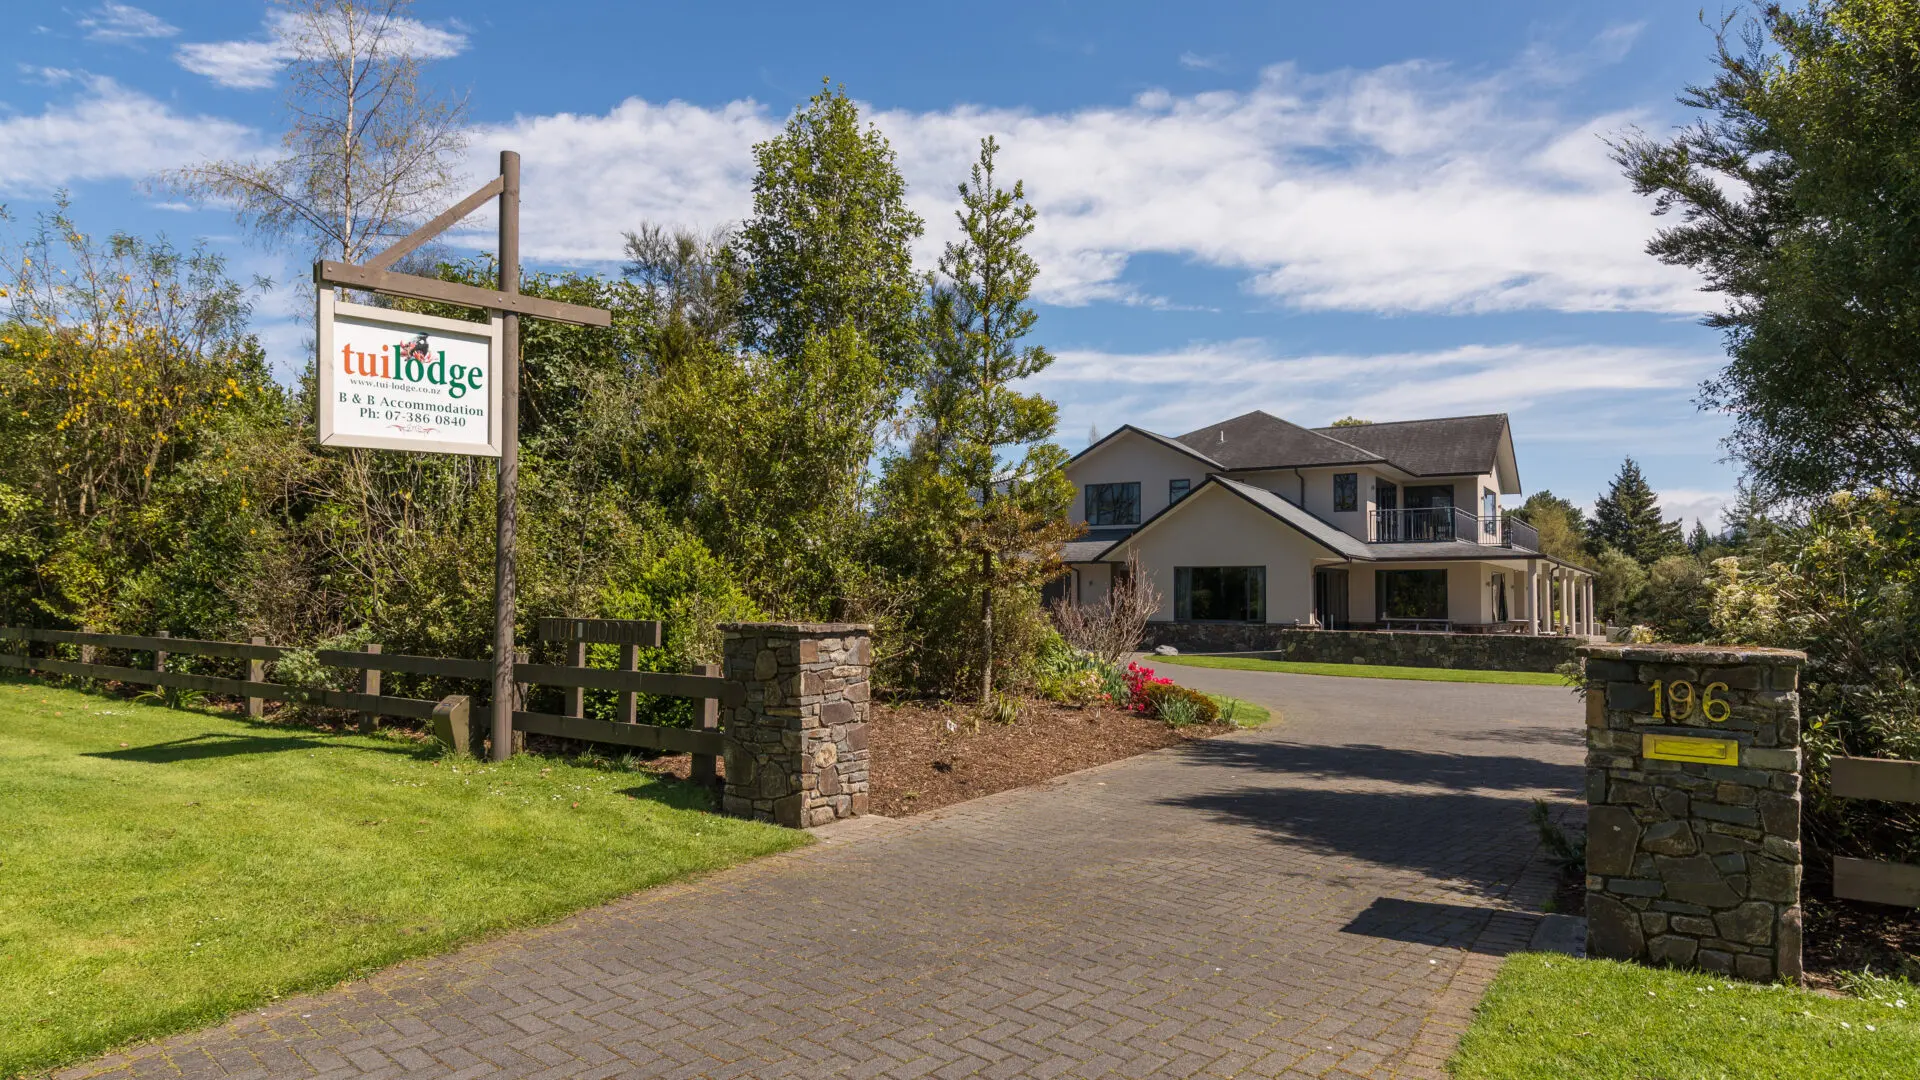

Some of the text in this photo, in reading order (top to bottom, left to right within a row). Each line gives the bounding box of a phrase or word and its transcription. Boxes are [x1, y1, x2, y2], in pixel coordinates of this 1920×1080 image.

[350, 378, 441, 395] www.tui-lodge.co.nz
[339, 392, 484, 417] B & B Accommodation
[359, 407, 466, 427] Ph: 07-386 0840
[1648, 679, 1731, 723] 196
